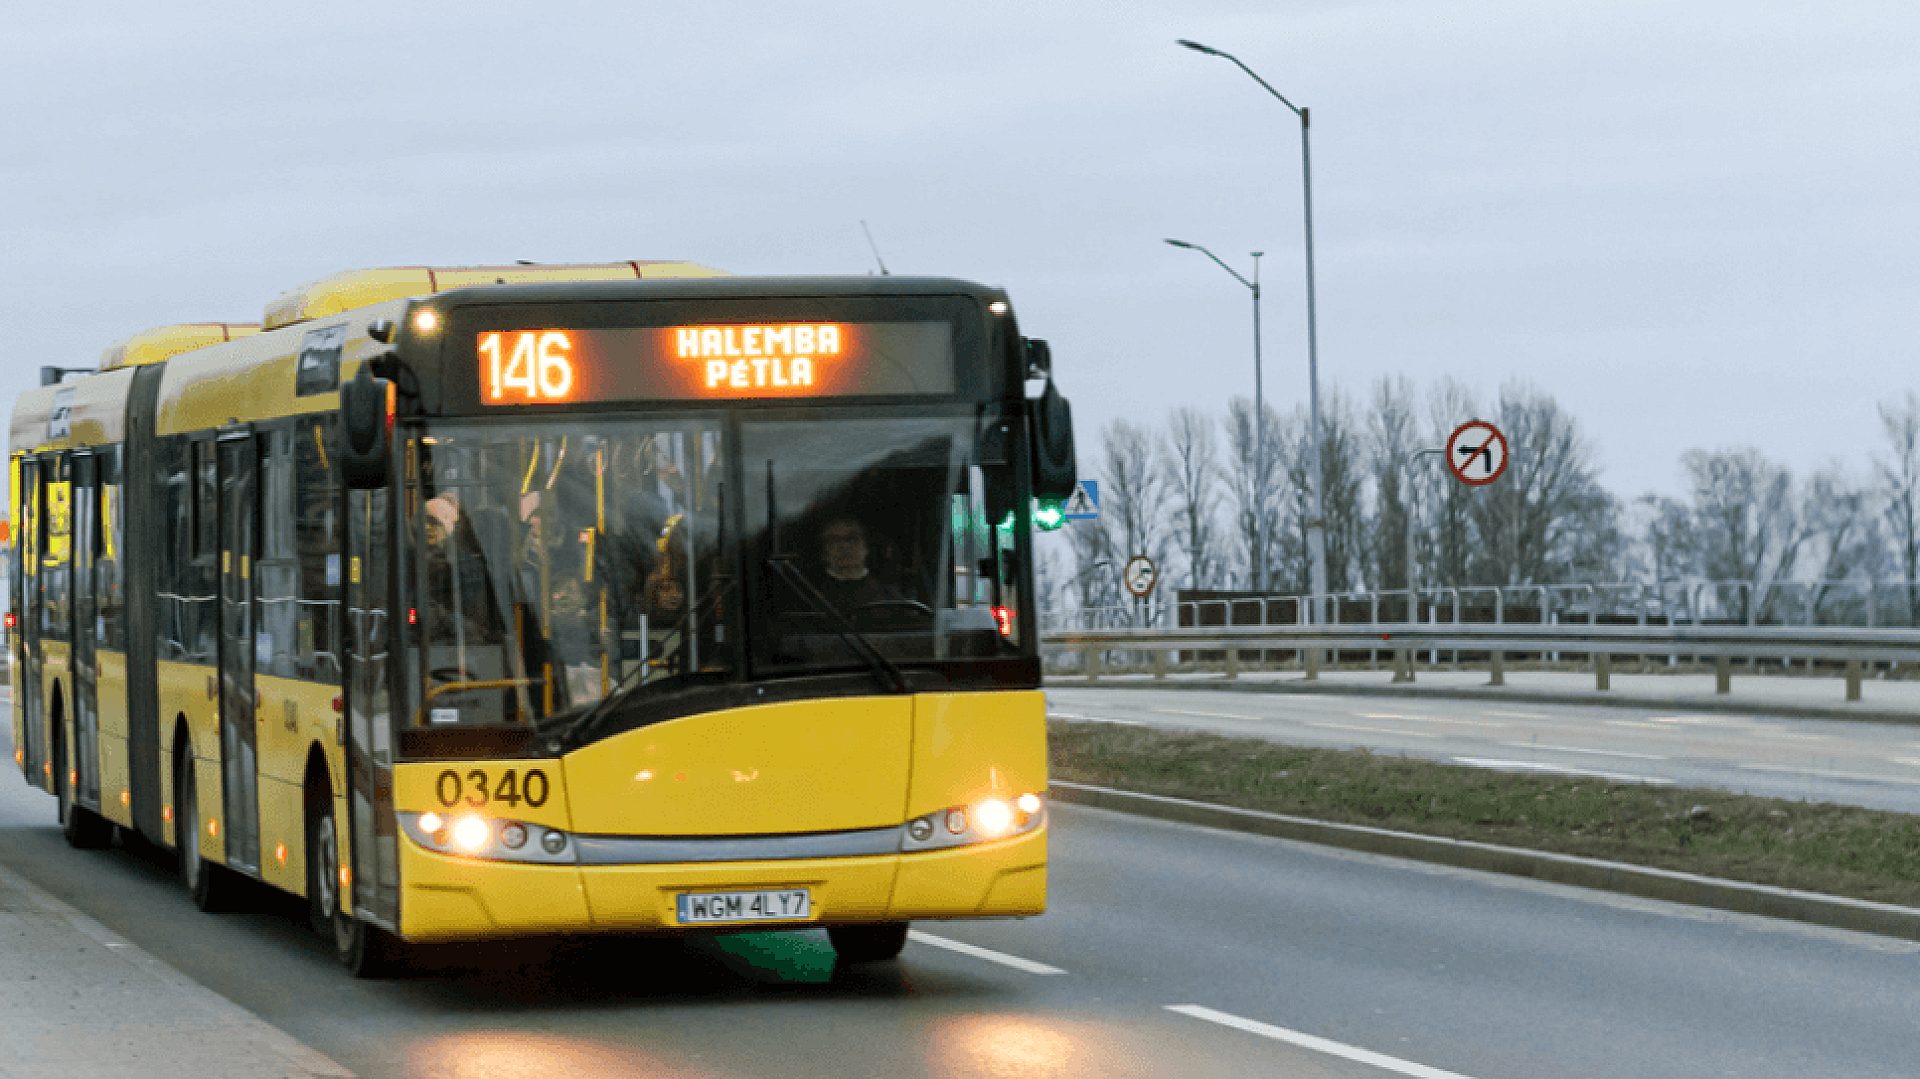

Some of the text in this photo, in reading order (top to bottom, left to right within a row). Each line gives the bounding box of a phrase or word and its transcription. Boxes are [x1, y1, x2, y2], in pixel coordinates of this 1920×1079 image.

[678, 326, 840, 357] HALEMBA
[479, 333, 572, 398] 146
[436, 769, 550, 807] 0340
[691, 892, 806, 918] WGM 4LY7
